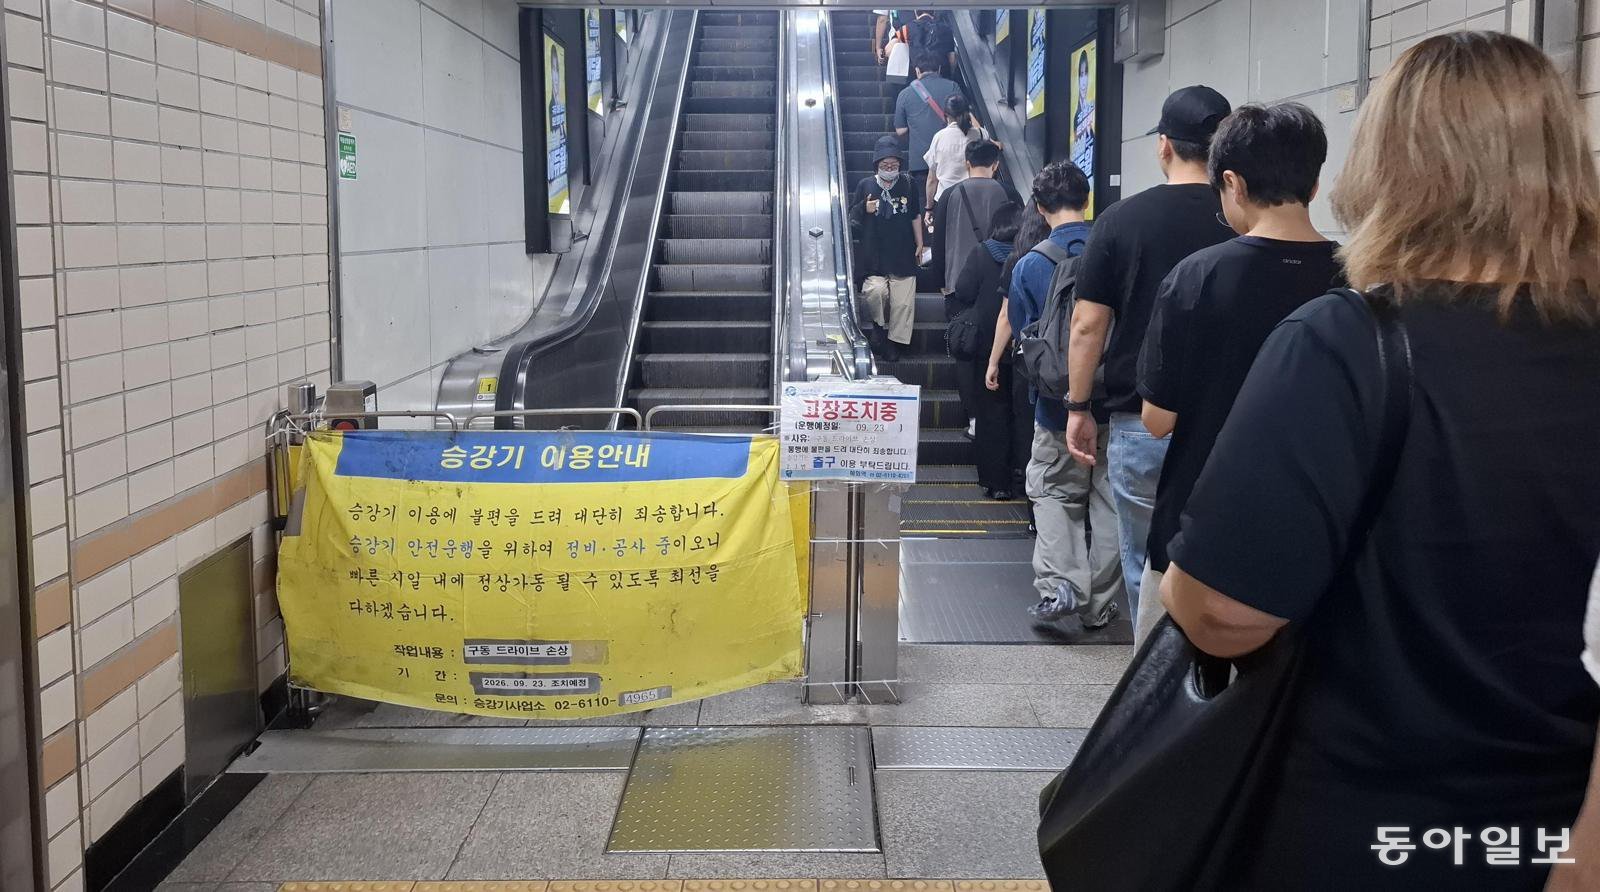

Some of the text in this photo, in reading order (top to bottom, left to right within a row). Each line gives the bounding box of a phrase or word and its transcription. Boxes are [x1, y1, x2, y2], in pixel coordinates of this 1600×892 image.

[487, 383, 492, 392] 1
[802, 400, 898, 422] 고장조치중
[873, 423, 885, 432] 23
[440, 444, 651, 471] 승강기 이용안내
[812, 457, 836, 469] 출구
[840, 460, 857, 469] 이용
[348, 501, 724, 527] 승강기 이용에 불편을 드려 대단히 죄송합니다.
[348, 534, 396, 556] 승강기
[408, 538, 493, 560] 안전운행을
[503, 540, 553, 559] 위하여
[655, 531, 721, 556] 중이오니
[349, 563, 720, 593] 빠른 시일 내에 정상가동 될 수 있도록 최선을
[348, 598, 454, 623] 다하겠습니다.
[394, 644, 444, 659] 작업내용
[467, 645, 491, 657] 구동
[496, 645, 541, 656] 드라이브
[545, 645, 569, 657] 손상
[397, 667, 410, 678] 기
[434, 670, 448, 682] 간
[483, 679, 510, 688] 2026.
[513, 679, 529, 688] 09.
[532, 679, 548, 688] 23.
[551, 678, 587, 688] 조치예정
[434, 694, 458, 706] 문의
[473, 696, 546, 712] 승강기사업소
